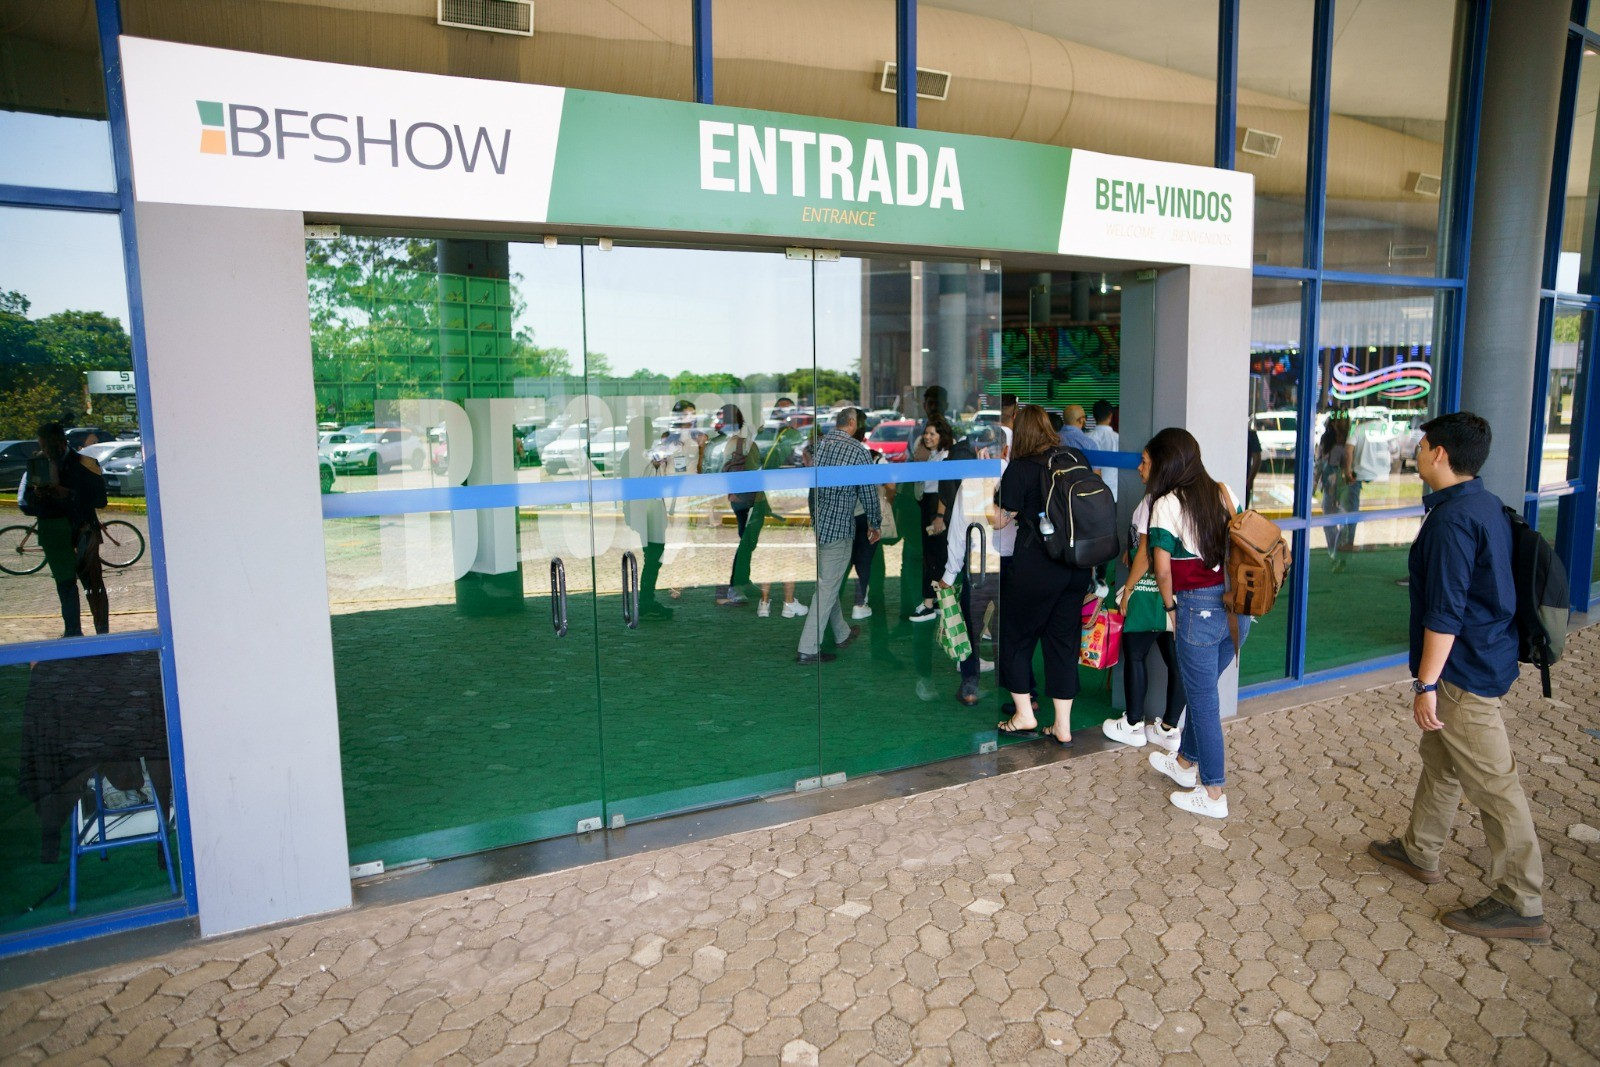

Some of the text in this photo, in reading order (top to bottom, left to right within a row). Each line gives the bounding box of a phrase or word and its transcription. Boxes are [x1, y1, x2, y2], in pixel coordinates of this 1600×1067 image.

[228, 103, 511, 175] BFSHOW
[699, 120, 964, 210] ENTRADA
[802, 206, 876, 227] ENTRANCE
[1096, 177, 1232, 223] BEM-VINDOS
[1106, 223, 1156, 240] WELCOME
[1171, 229, 1232, 247] BIENVENIDOS
